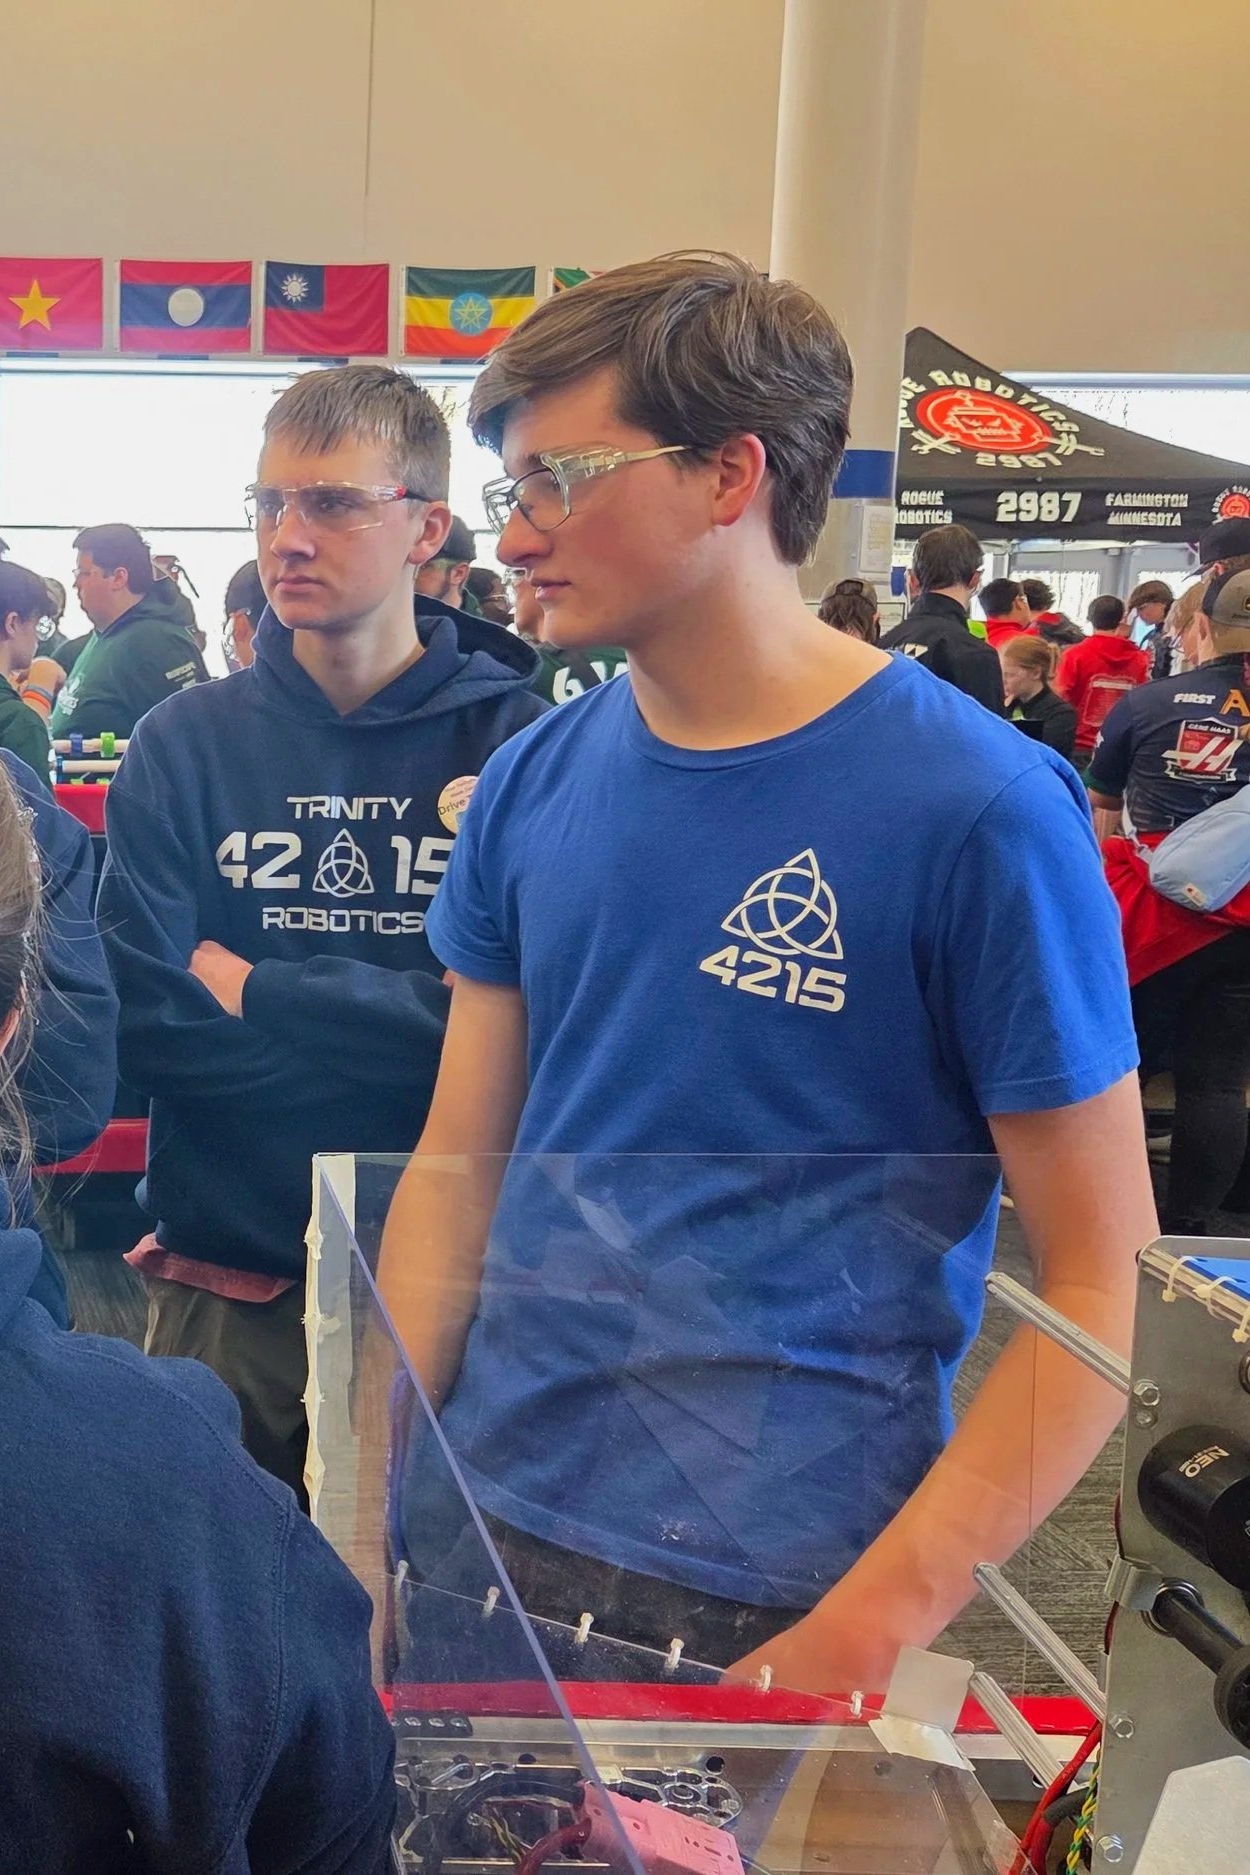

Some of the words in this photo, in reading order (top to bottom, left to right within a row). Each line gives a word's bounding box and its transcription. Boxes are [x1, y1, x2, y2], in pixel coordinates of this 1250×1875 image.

[928, 369, 1080, 433] ROBOTICS
[975, 451, 1063, 469] 2987
[901, 489, 945, 506] ROGUE
[995, 490, 1082, 522] 2987
[1105, 492, 1188, 507] FARMINGTON
[1107, 511, 1182, 526] MINNESOTA
[1173, 693, 1216, 705] FIRST
[287, 796, 412, 820] TRINITY
[438, 799, 466, 815] Drive
[215, 831, 302, 889] 42
[391, 835, 456, 896] 15
[262, 907, 424, 935] ROBOTICS
[699, 945, 847, 1012] 4215
[1184, 1445, 1230, 1478] NEO
